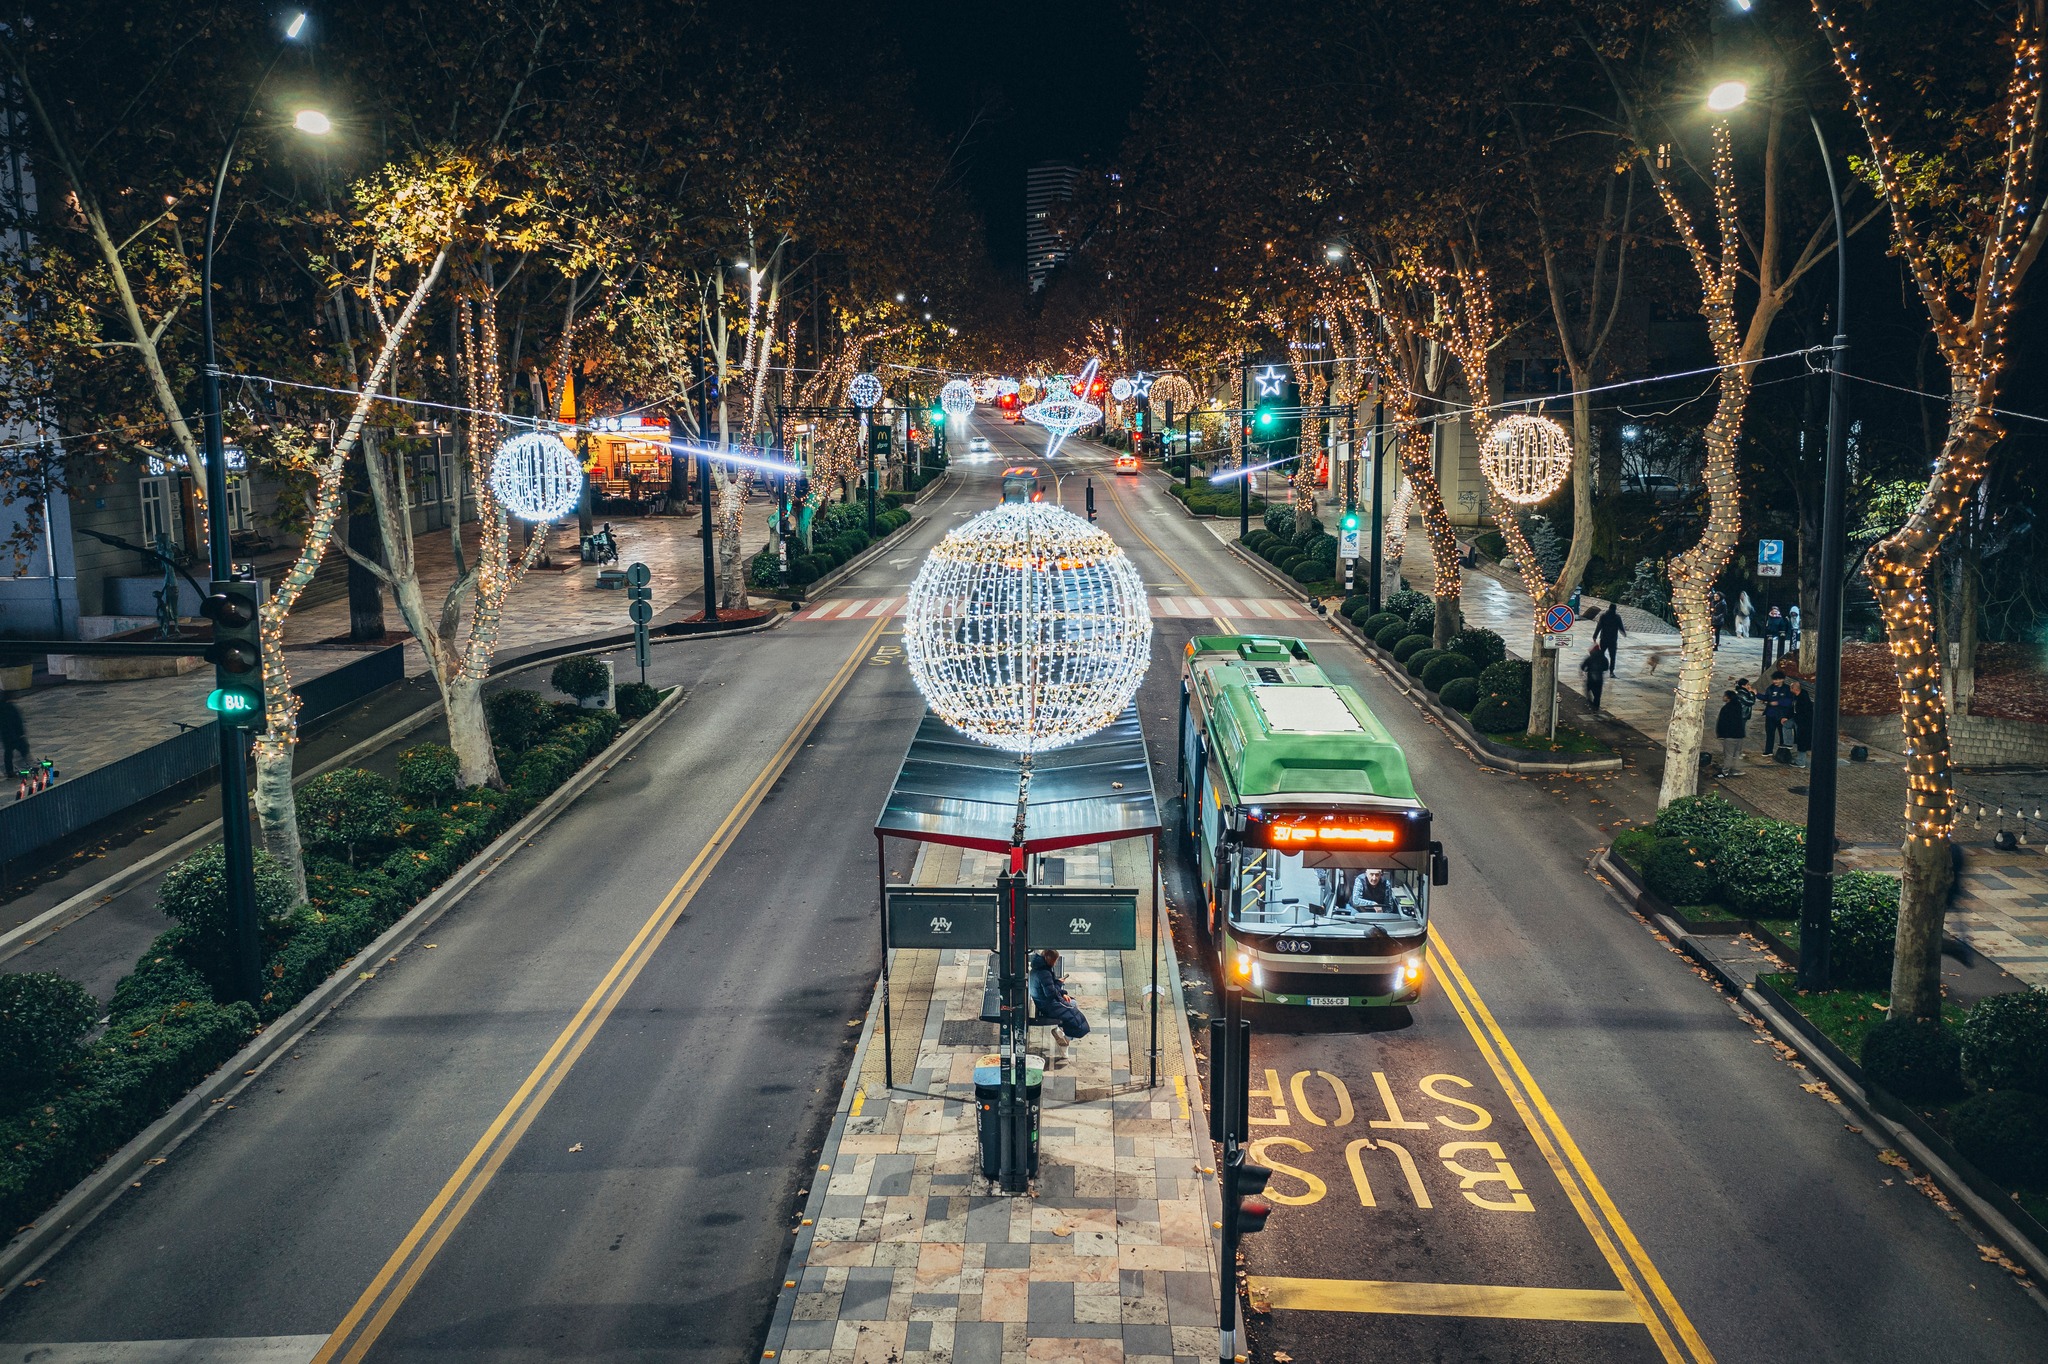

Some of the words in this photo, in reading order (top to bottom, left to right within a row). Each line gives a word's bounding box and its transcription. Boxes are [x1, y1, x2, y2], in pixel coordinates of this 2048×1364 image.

[1764, 543, 1778, 561] P
[225, 694, 252, 710] BU
[1248, 1136, 1537, 1213] BUS
